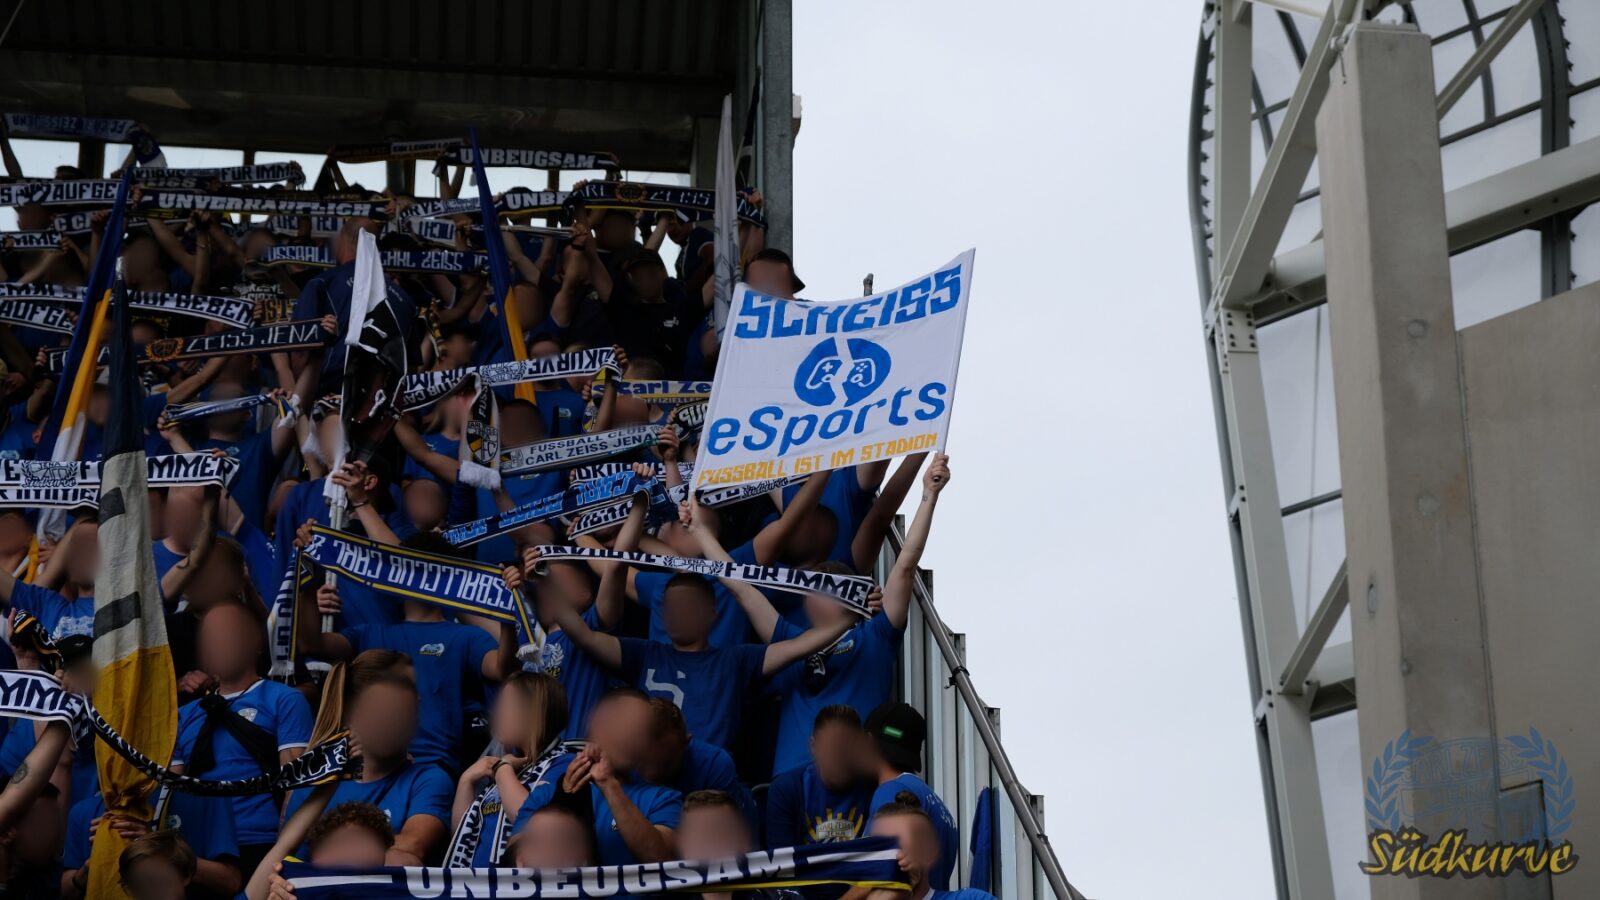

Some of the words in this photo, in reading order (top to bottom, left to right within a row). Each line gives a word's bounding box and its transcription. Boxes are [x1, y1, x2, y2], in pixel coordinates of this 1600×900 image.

[260, 325, 319, 345] JENA
[706, 382, 947, 457] eSports
[525, 450, 563, 466] CARL
[567, 442, 609, 457] ZEISS
[613, 432, 653, 447] JENA
[530, 434, 601, 455] FUSSBALL
[697, 457, 787, 485] FUSSBALL
[794, 452, 824, 474] IST
[830, 447, 854, 468] IM
[860, 432, 938, 459] STADION
[405, 847, 796, 899] UNBEUGSAM
